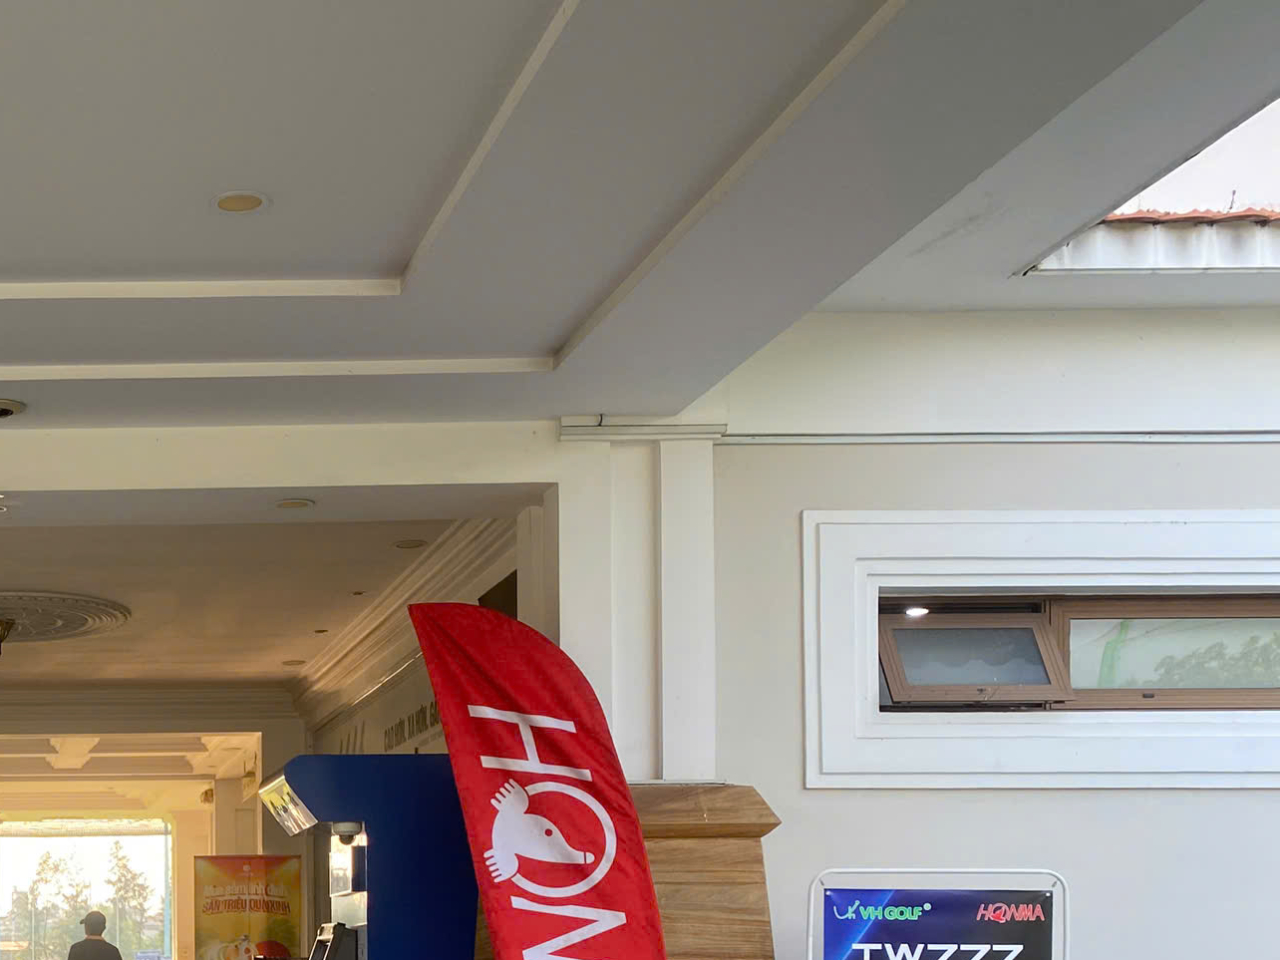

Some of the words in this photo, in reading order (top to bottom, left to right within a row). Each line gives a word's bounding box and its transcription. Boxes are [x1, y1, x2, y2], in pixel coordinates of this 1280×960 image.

[858, 905, 883, 920] VH
[883, 905, 923, 921] GOLF
[976, 902, 1045, 924] HONMA
